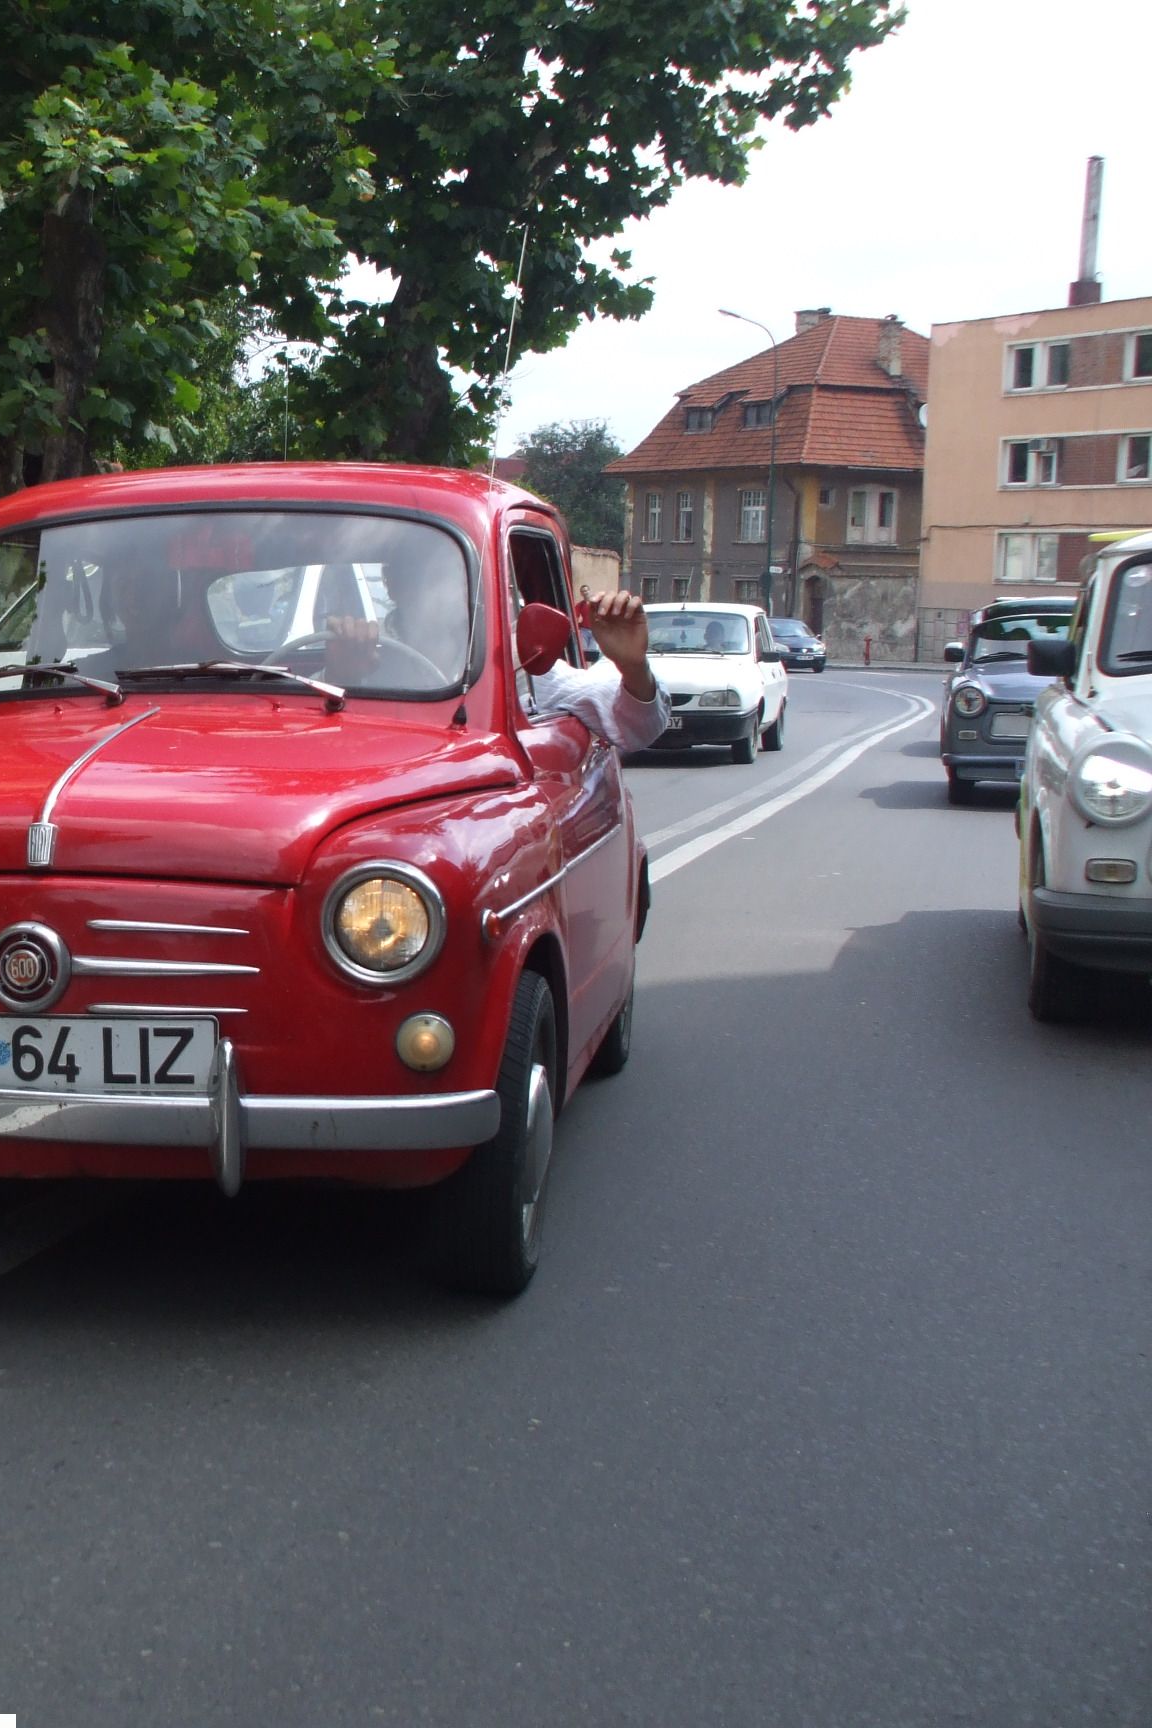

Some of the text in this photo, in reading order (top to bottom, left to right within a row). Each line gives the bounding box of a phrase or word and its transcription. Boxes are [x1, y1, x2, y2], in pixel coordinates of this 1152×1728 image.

[11, 958, 35, 979] 600
[11, 1025, 79, 1083] 64
[102, 1027, 195, 1084] LIZ
